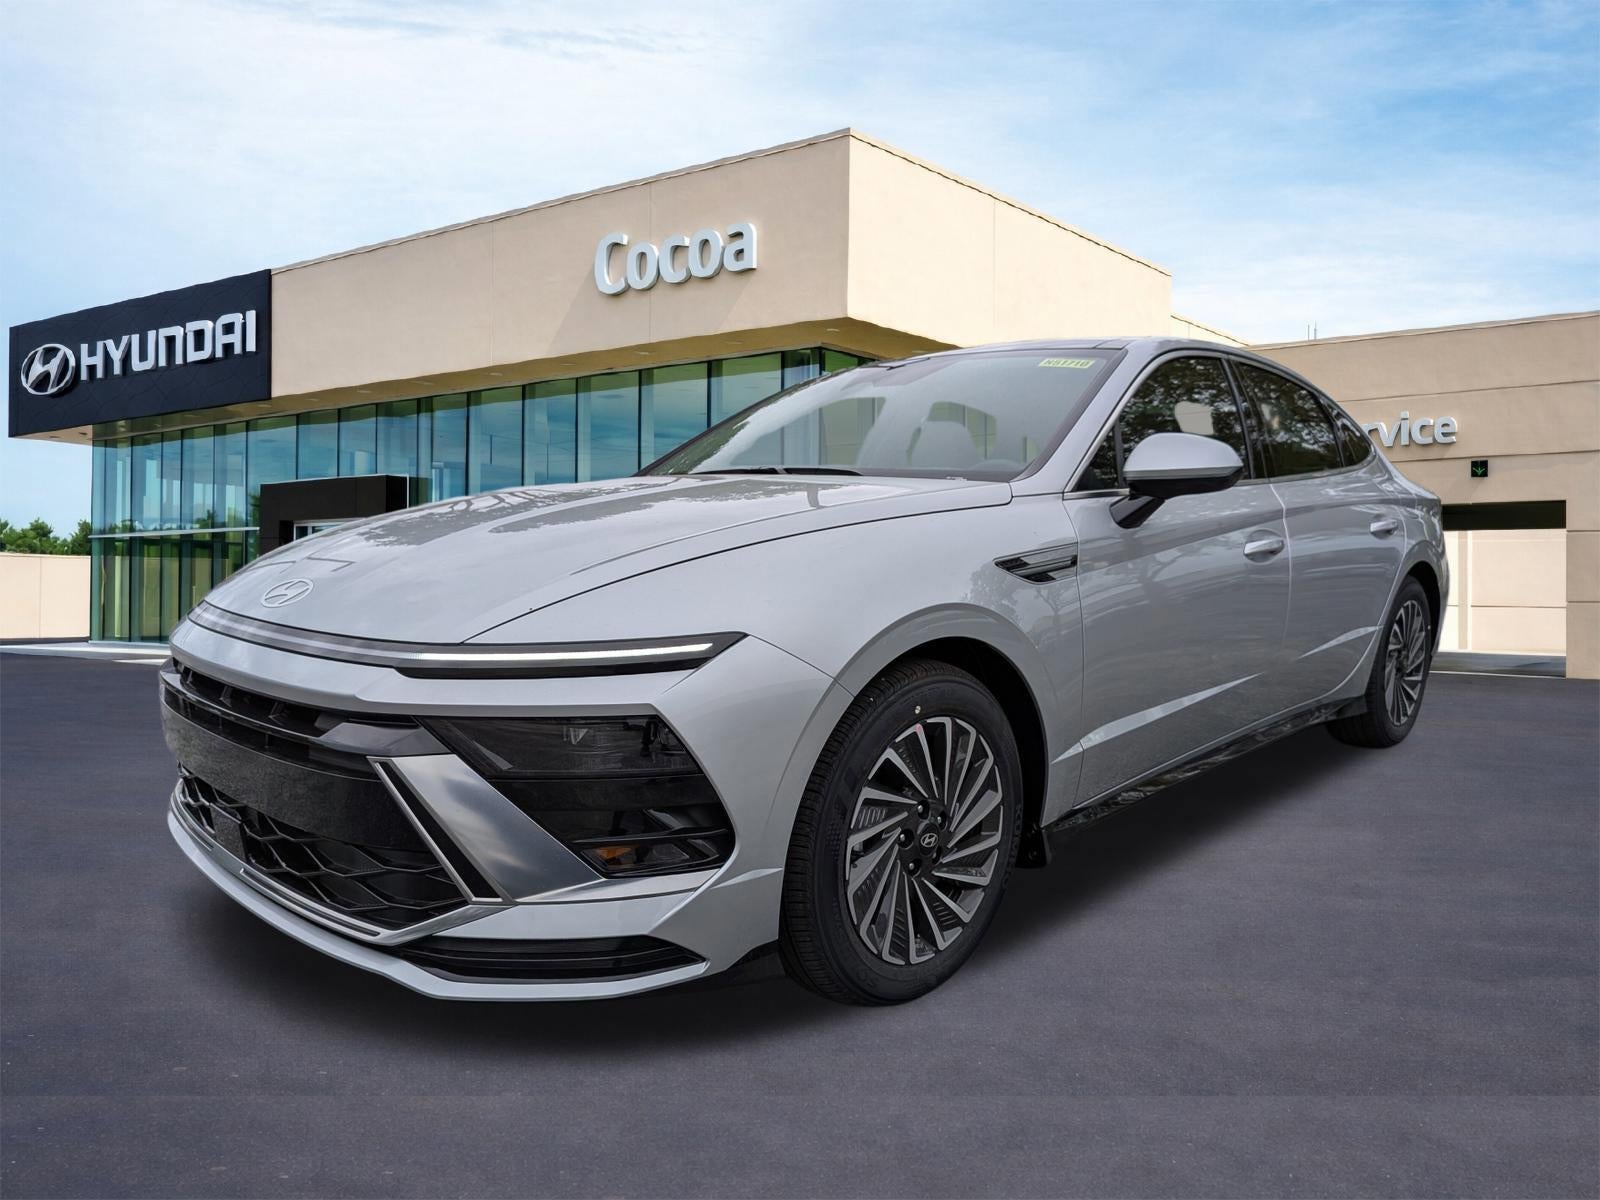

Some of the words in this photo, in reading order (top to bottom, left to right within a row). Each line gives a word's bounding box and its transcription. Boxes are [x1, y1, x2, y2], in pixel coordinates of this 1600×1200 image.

[594, 223, 757, 295] Cocoa
[80, 309, 257, 381] HYUNDAI
[1361, 410, 1458, 447] rvice
